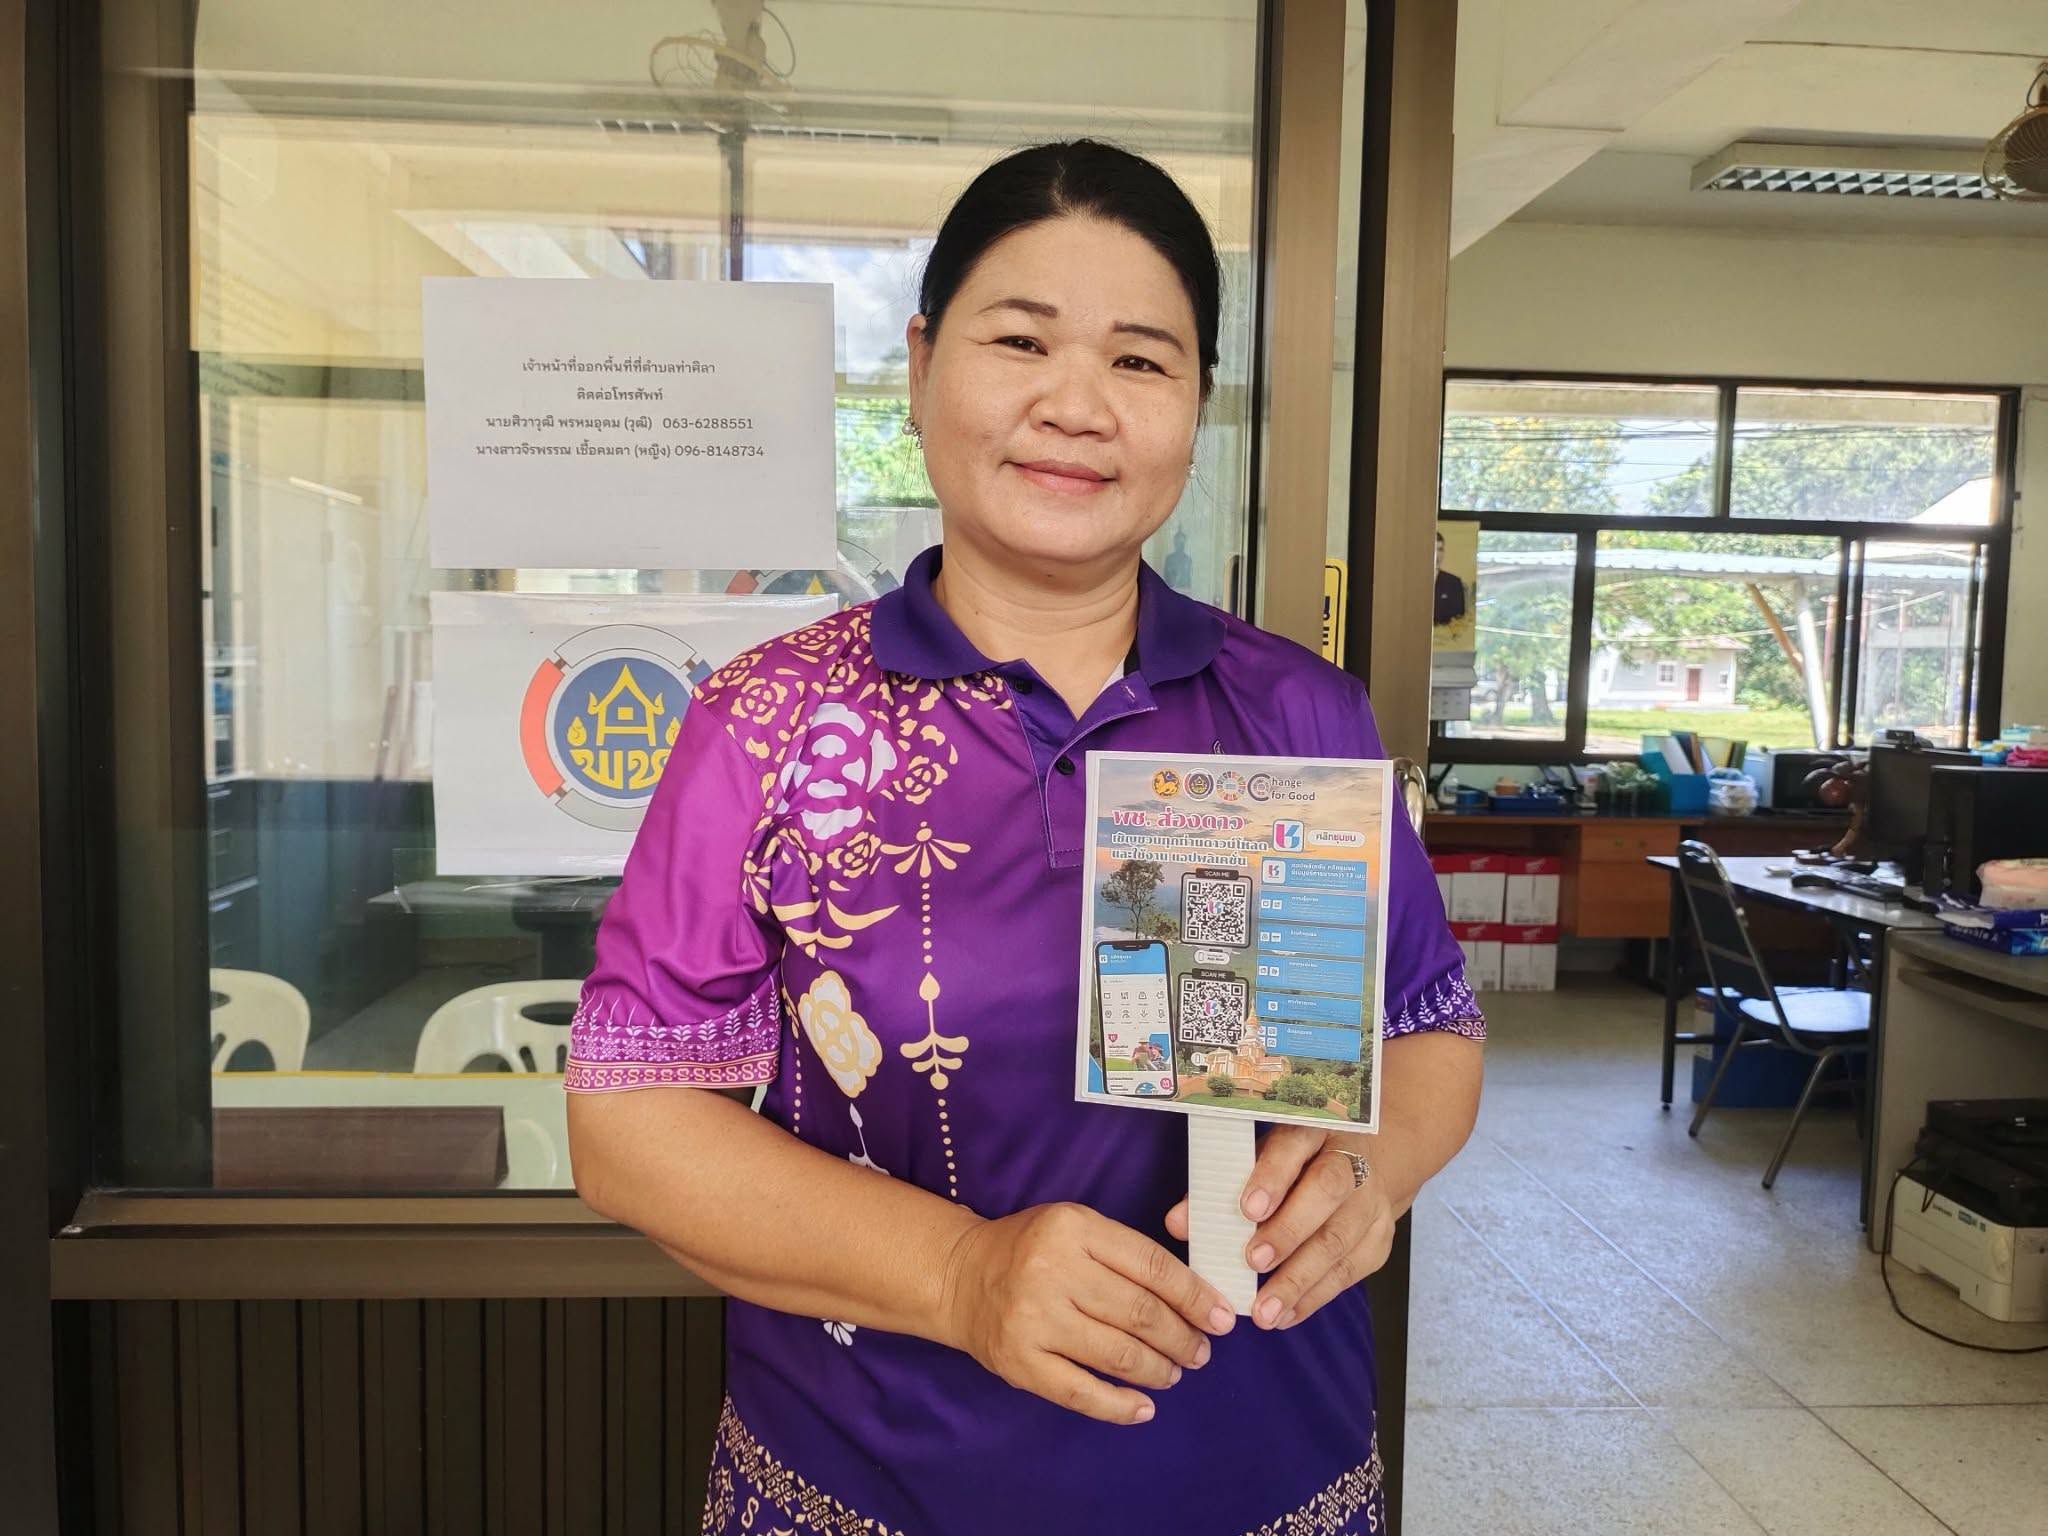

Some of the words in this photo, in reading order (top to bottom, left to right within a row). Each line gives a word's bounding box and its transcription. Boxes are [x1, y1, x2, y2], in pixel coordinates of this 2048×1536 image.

[577, 386, 663, 400] ติดต่อโทรศัพท์
[624, 415, 652, 432] (วุฒิ)
[663, 418, 753, 429] 063-6288551
[634, 443, 671, 460] (หญิง)
[675, 445, 763, 456] 096-8148734
[1271, 791, 1285, 800] for
[1288, 791, 1316, 801] Good
[1112, 809, 1151, 827] พช.
[1157, 806, 1246, 830] ส่องดาว
[1201, 970, 1217, 978] SCAN
